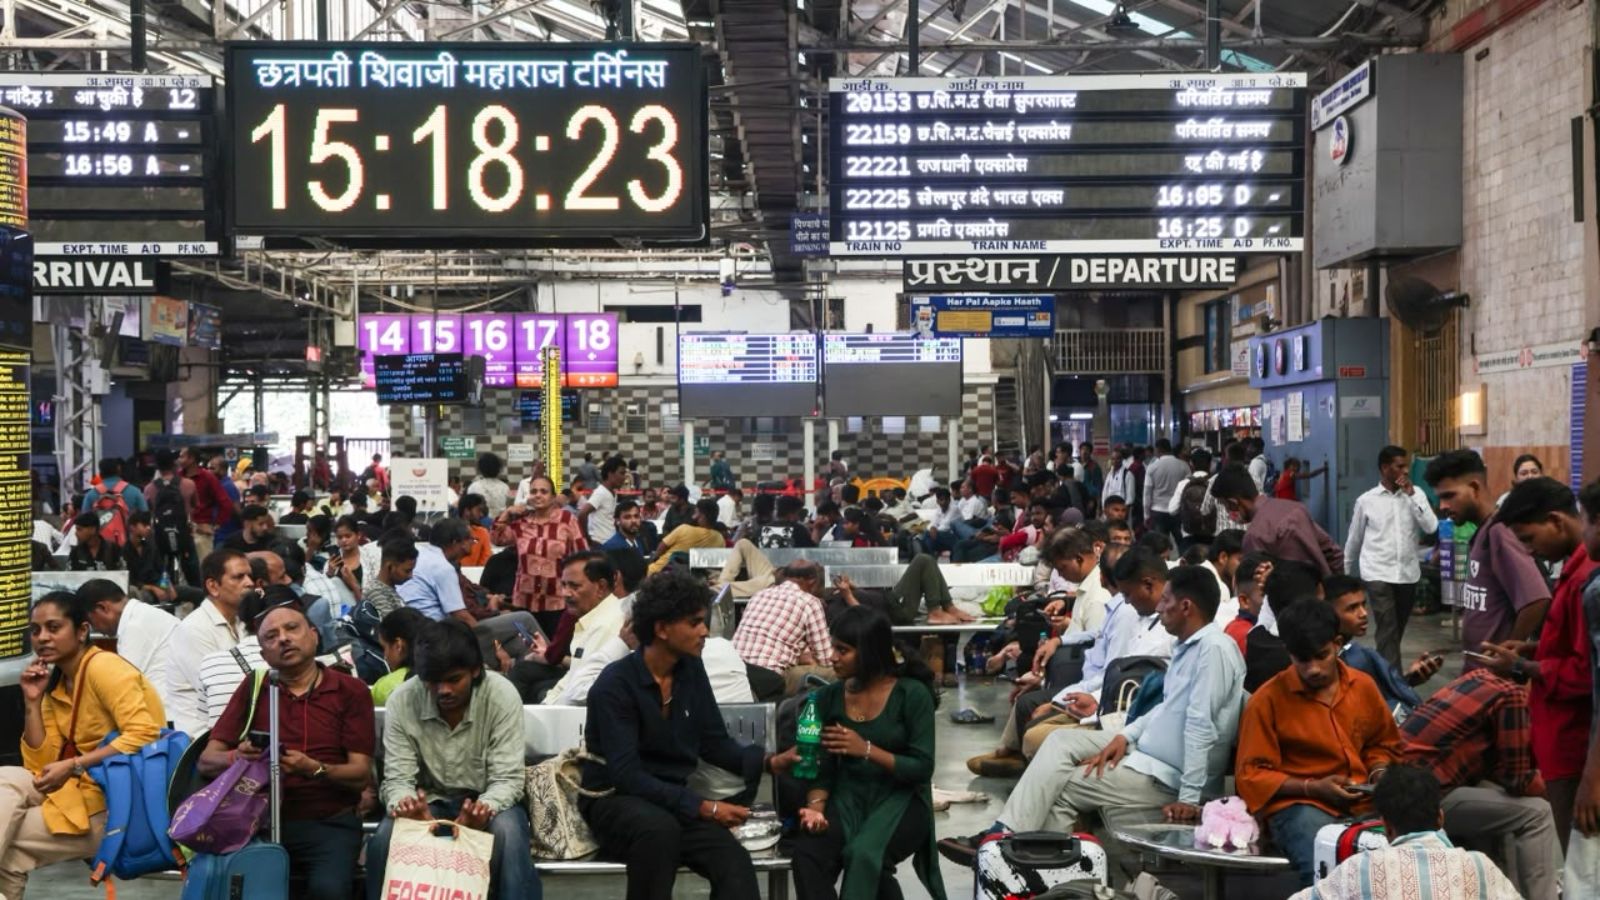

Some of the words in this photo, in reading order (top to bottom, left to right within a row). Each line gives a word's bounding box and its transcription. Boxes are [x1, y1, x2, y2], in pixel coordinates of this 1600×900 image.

[253, 51, 353, 87] छत्रपती
[359, 51, 458, 87] शिवाजी
[463, 61, 568, 89] महाराज
[572, 50, 668, 87] टर्मिनस
[169, 90, 196, 107] 12
[847, 91, 911, 112] 20153
[64, 121, 131, 142] 15:49
[144, 122, 158, 142] A
[847, 124, 911, 144] 22159
[65, 155, 132, 175] 16:50
[146, 155, 160, 175] A
[252, 104, 682, 212] 15:18:23
[847, 157, 910, 176] 22221
[847, 189, 911, 208] 22225
[1158, 185, 1224, 206] 16:05
[1234, 185, 1252, 205] D
[848, 221, 911, 240] 12125
[1157, 217, 1223, 239] 16:25
[1234, 217, 1250, 237] D
[63, 245, 96, 254] EXPT.
[100, 245, 128, 254] TIME
[846, 241, 880, 250] TRAIN
[885, 241, 901, 250] NO
[972, 240, 1008, 250] TRAIN
[1012, 240, 1047, 249] NAME
[1160, 239, 1191, 248] EXPT.
[1197, 239, 1223, 248] TIME
[907, 258, 1040, 285] प्रस्थान
[1071, 258, 1235, 282] DEPARTURE
[365, 321, 404, 351] 14
[418, 320, 455, 352] 15
[470, 320, 507, 351] 16
[522, 320, 559, 352] 17
[574, 320, 610, 350] 18
[797, 724, 822, 740] Sprite
